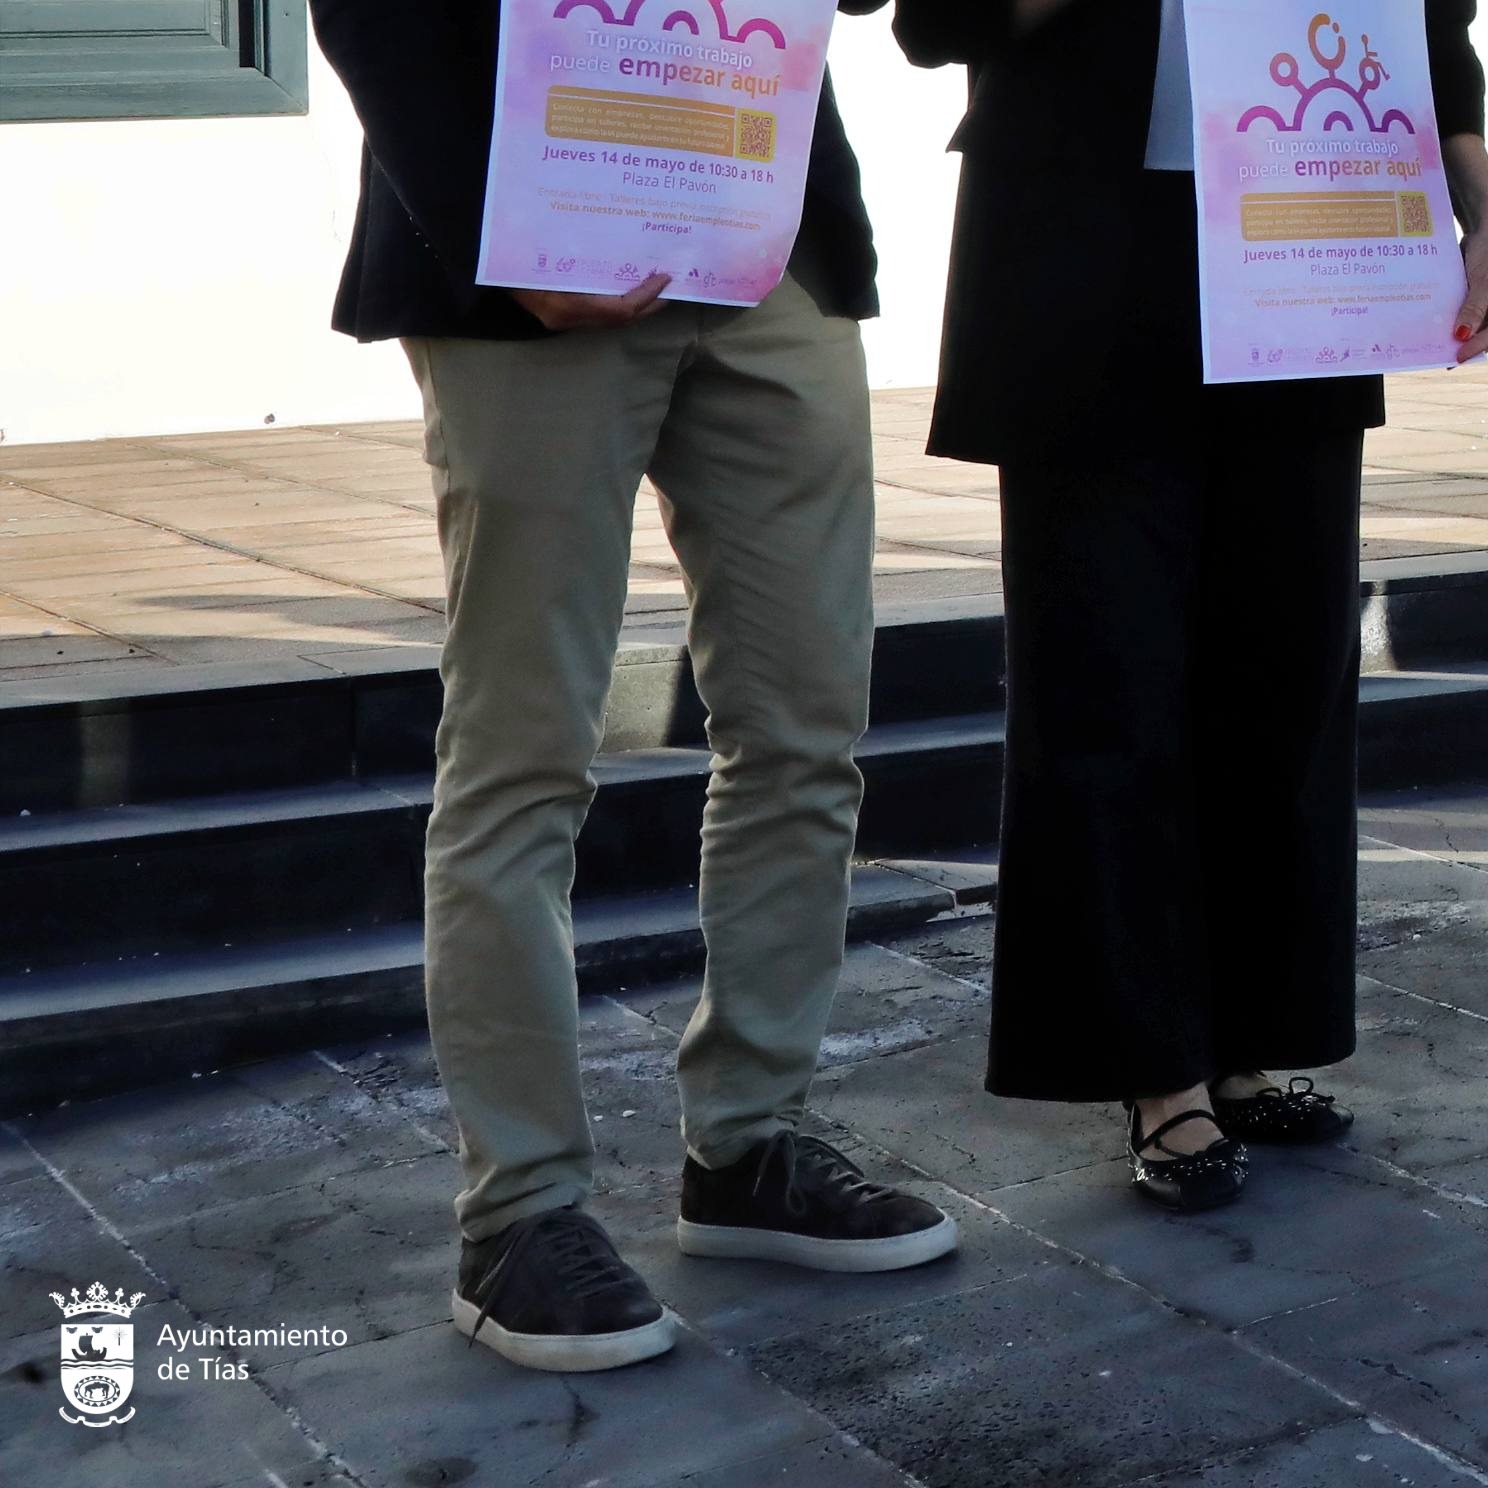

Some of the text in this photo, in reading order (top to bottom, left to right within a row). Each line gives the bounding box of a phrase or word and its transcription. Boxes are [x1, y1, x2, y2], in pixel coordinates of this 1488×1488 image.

[587, 30, 752, 71] Tu próximo trabajo
[550, 54, 782, 99] puede empezar aquí
[1266, 139, 1398, 157] Tu trabajo
[542, 145, 774, 184] Jueves 14 de mayo de 10:30 a 18 h
[1239, 158, 1421, 181] puede empezar aquí
[622, 171, 716, 194] Plaza El Pavón
[550, 201, 580, 214] Visita
[582, 205, 623, 217] nuestra
[641, 222, 692, 234] ¡Participa!
[1243, 244, 1437, 264] Jueves 14 de mayo de 10:30 a 18 h
[1310, 262, 1385, 275] Plaza El Pavón
